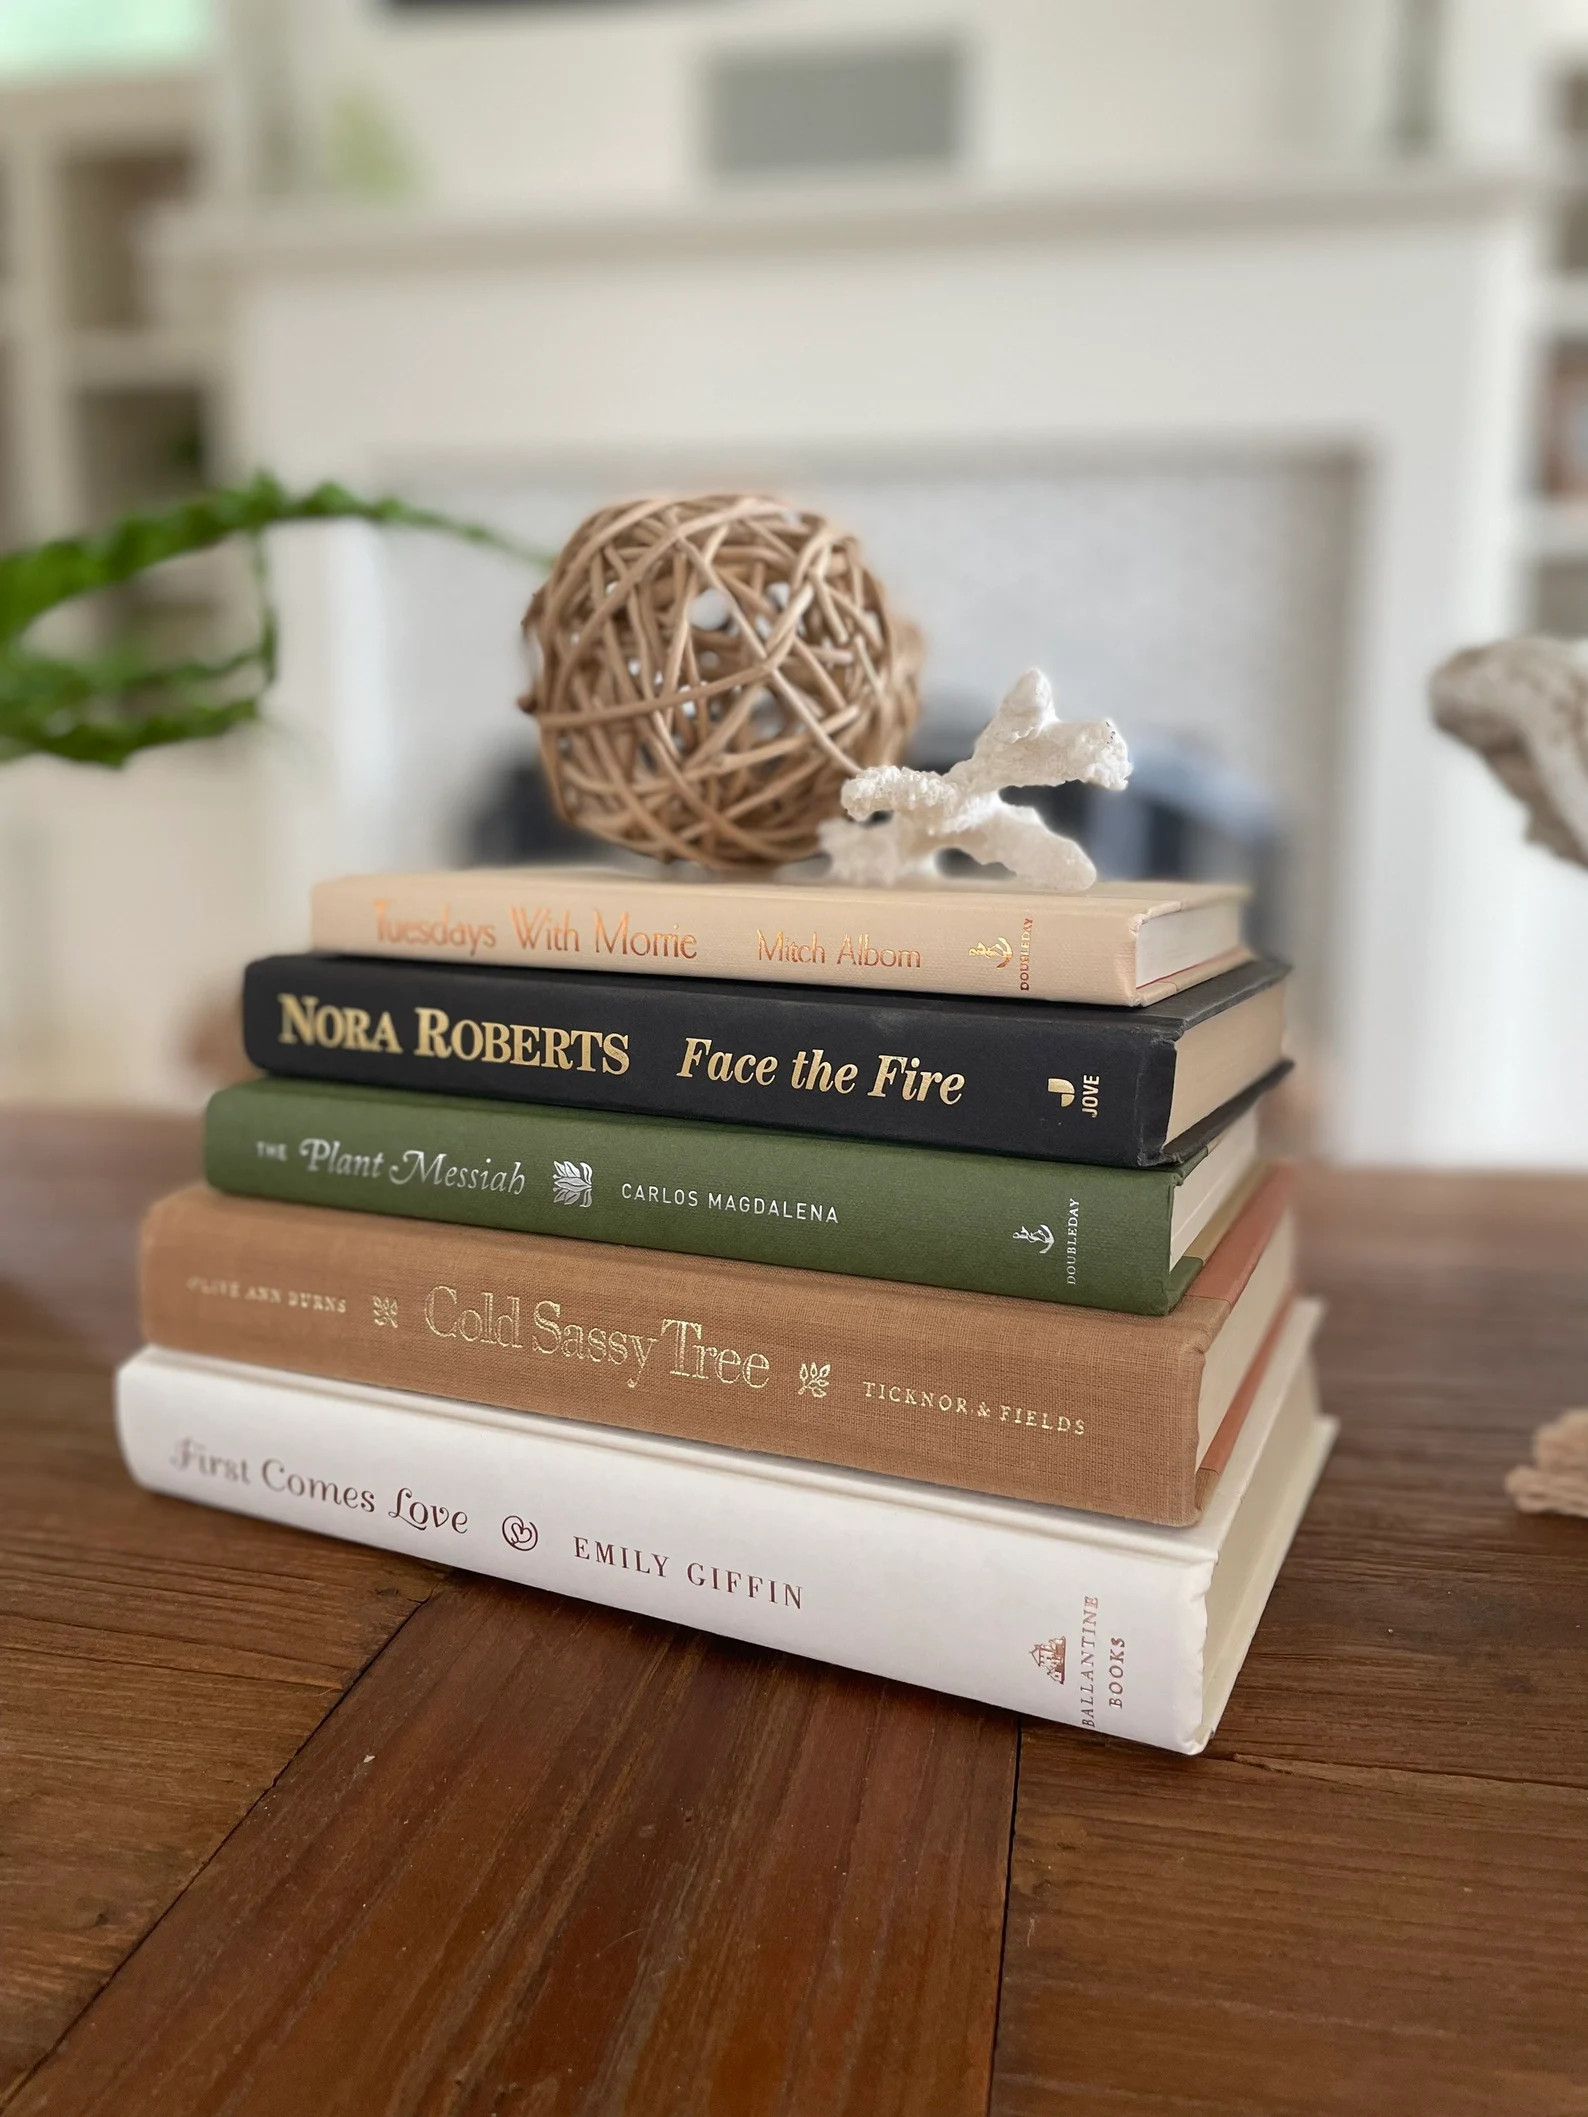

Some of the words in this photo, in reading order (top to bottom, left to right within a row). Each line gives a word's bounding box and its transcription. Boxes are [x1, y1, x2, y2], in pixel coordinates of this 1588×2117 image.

[373, 900, 496, 956] Tuesdays
[509, 905, 580, 952] With
[595, 909, 697, 960] Morrie
[757, 927, 825, 965] Mitch
[837, 933, 920, 968] Albom
[1020, 918, 1033, 991] DOUBLEDAY
[277, 993, 402, 1054] NORA
[414, 1007, 630, 1076] ROBERTS
[676, 1037, 778, 1086] Face
[790, 1049, 858, 1094] the
[868, 1054, 965, 1105] Fire
[1082, 1074, 1100, 1118] JOVE
[256, 1140, 287, 1162] THE
[299, 1138, 383, 1178] Plant
[389, 1150, 525, 1195] Messiah
[621, 1182, 699, 1208] CARLOS
[708, 1193, 839, 1224] MAGDALENA
[1066, 1197, 1080, 1286] DOUBLEDAY
[245, 1286, 282, 1304] ANN
[288, 1291, 346, 1313] BURNS
[424, 1285, 523, 1348] Cold
[532, 1300, 657, 1388] Sassy
[661, 1319, 770, 1388] Tree
[862, 1381, 968, 1415] TICKNOR
[977, 1401, 991, 1418] &
[1000, 1405, 1085, 1435] FIELDS
[169, 1437, 251, 1485] First
[261, 1458, 375, 1513] Comes
[388, 1488, 468, 1535] Love
[573, 1536, 670, 1578] EMILY
[687, 1562, 803, 1610] GIFFIN
[1080, 1596, 1099, 1728] BALLANTINE
[1108, 1637, 1125, 1709] BOOKS
